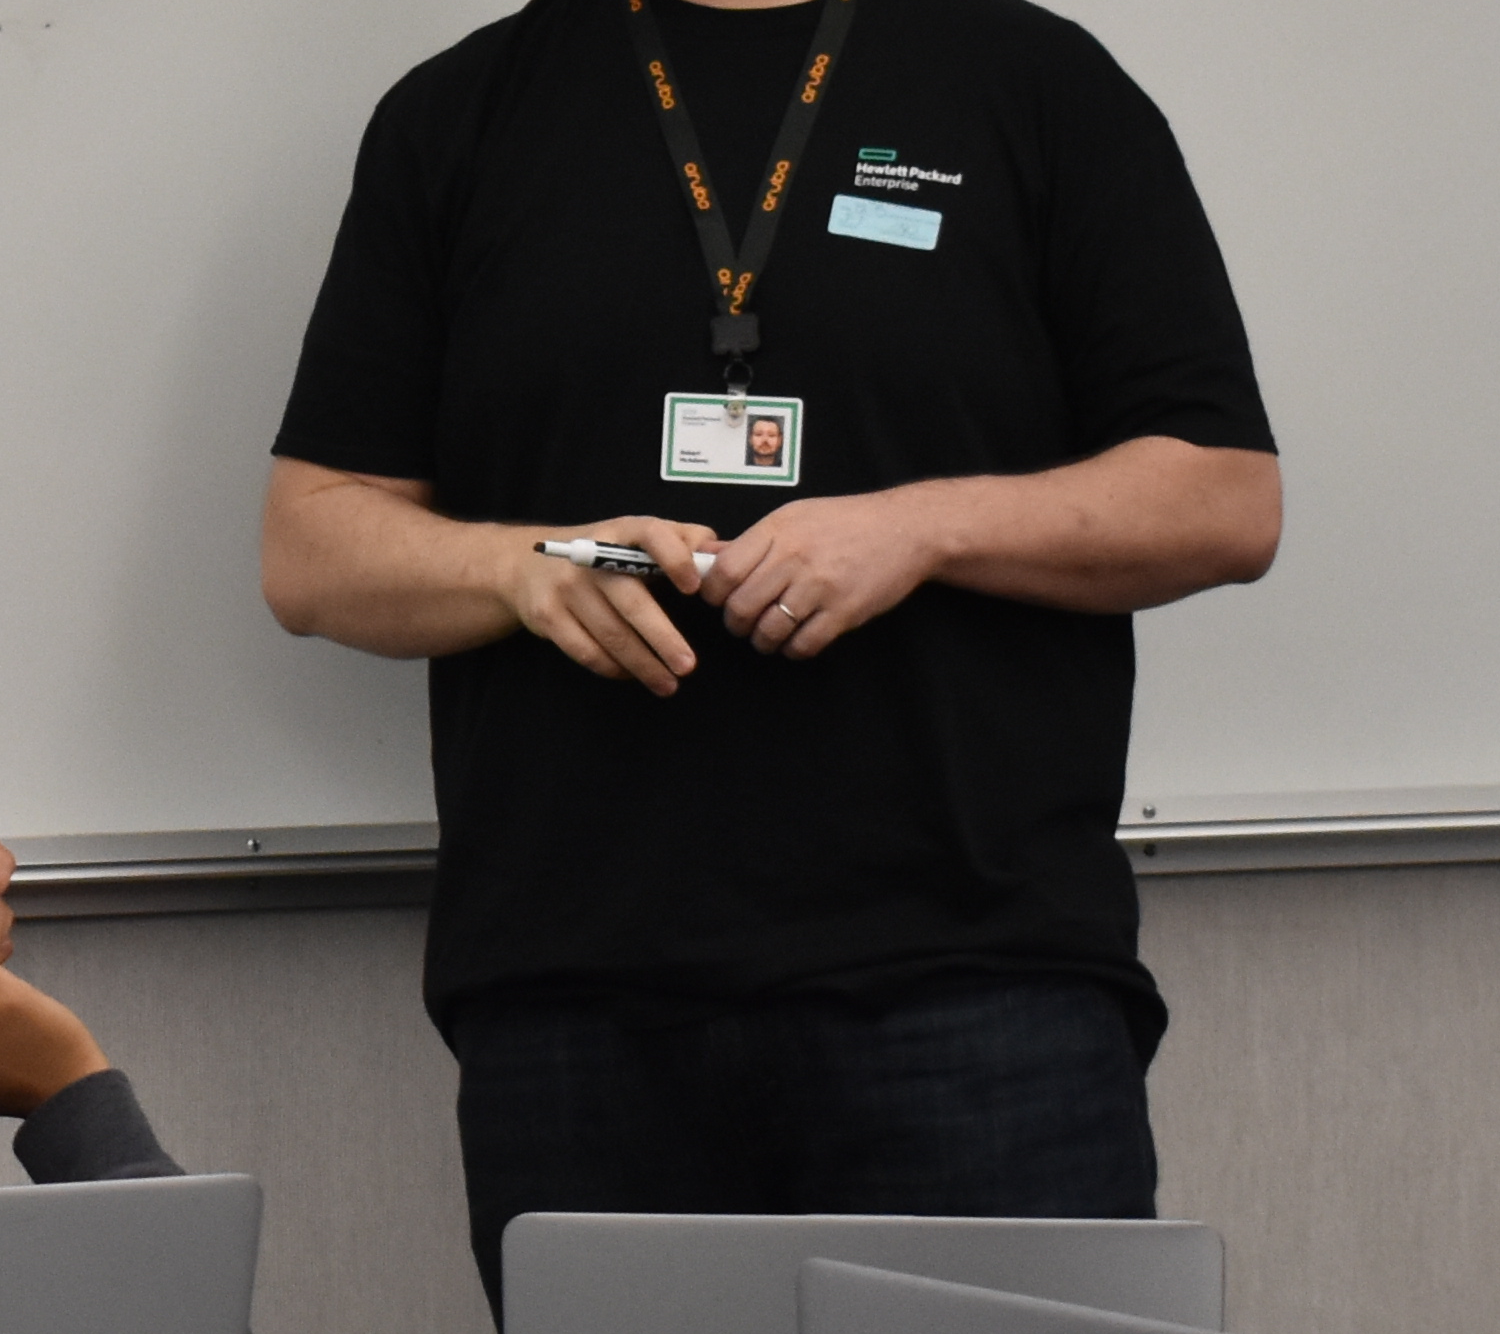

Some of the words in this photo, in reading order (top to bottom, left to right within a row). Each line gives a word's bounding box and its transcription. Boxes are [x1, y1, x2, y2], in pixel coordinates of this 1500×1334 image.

[649, 60, 675, 110] aruba
[801, 53, 831, 103] aruba
[684, 162, 711, 210] aruba
[762, 160, 791, 211] aruba
[854, 175, 920, 191] Enterprise
[856, 162, 908, 177] Hewlett
[909, 166, 963, 185] Packard
